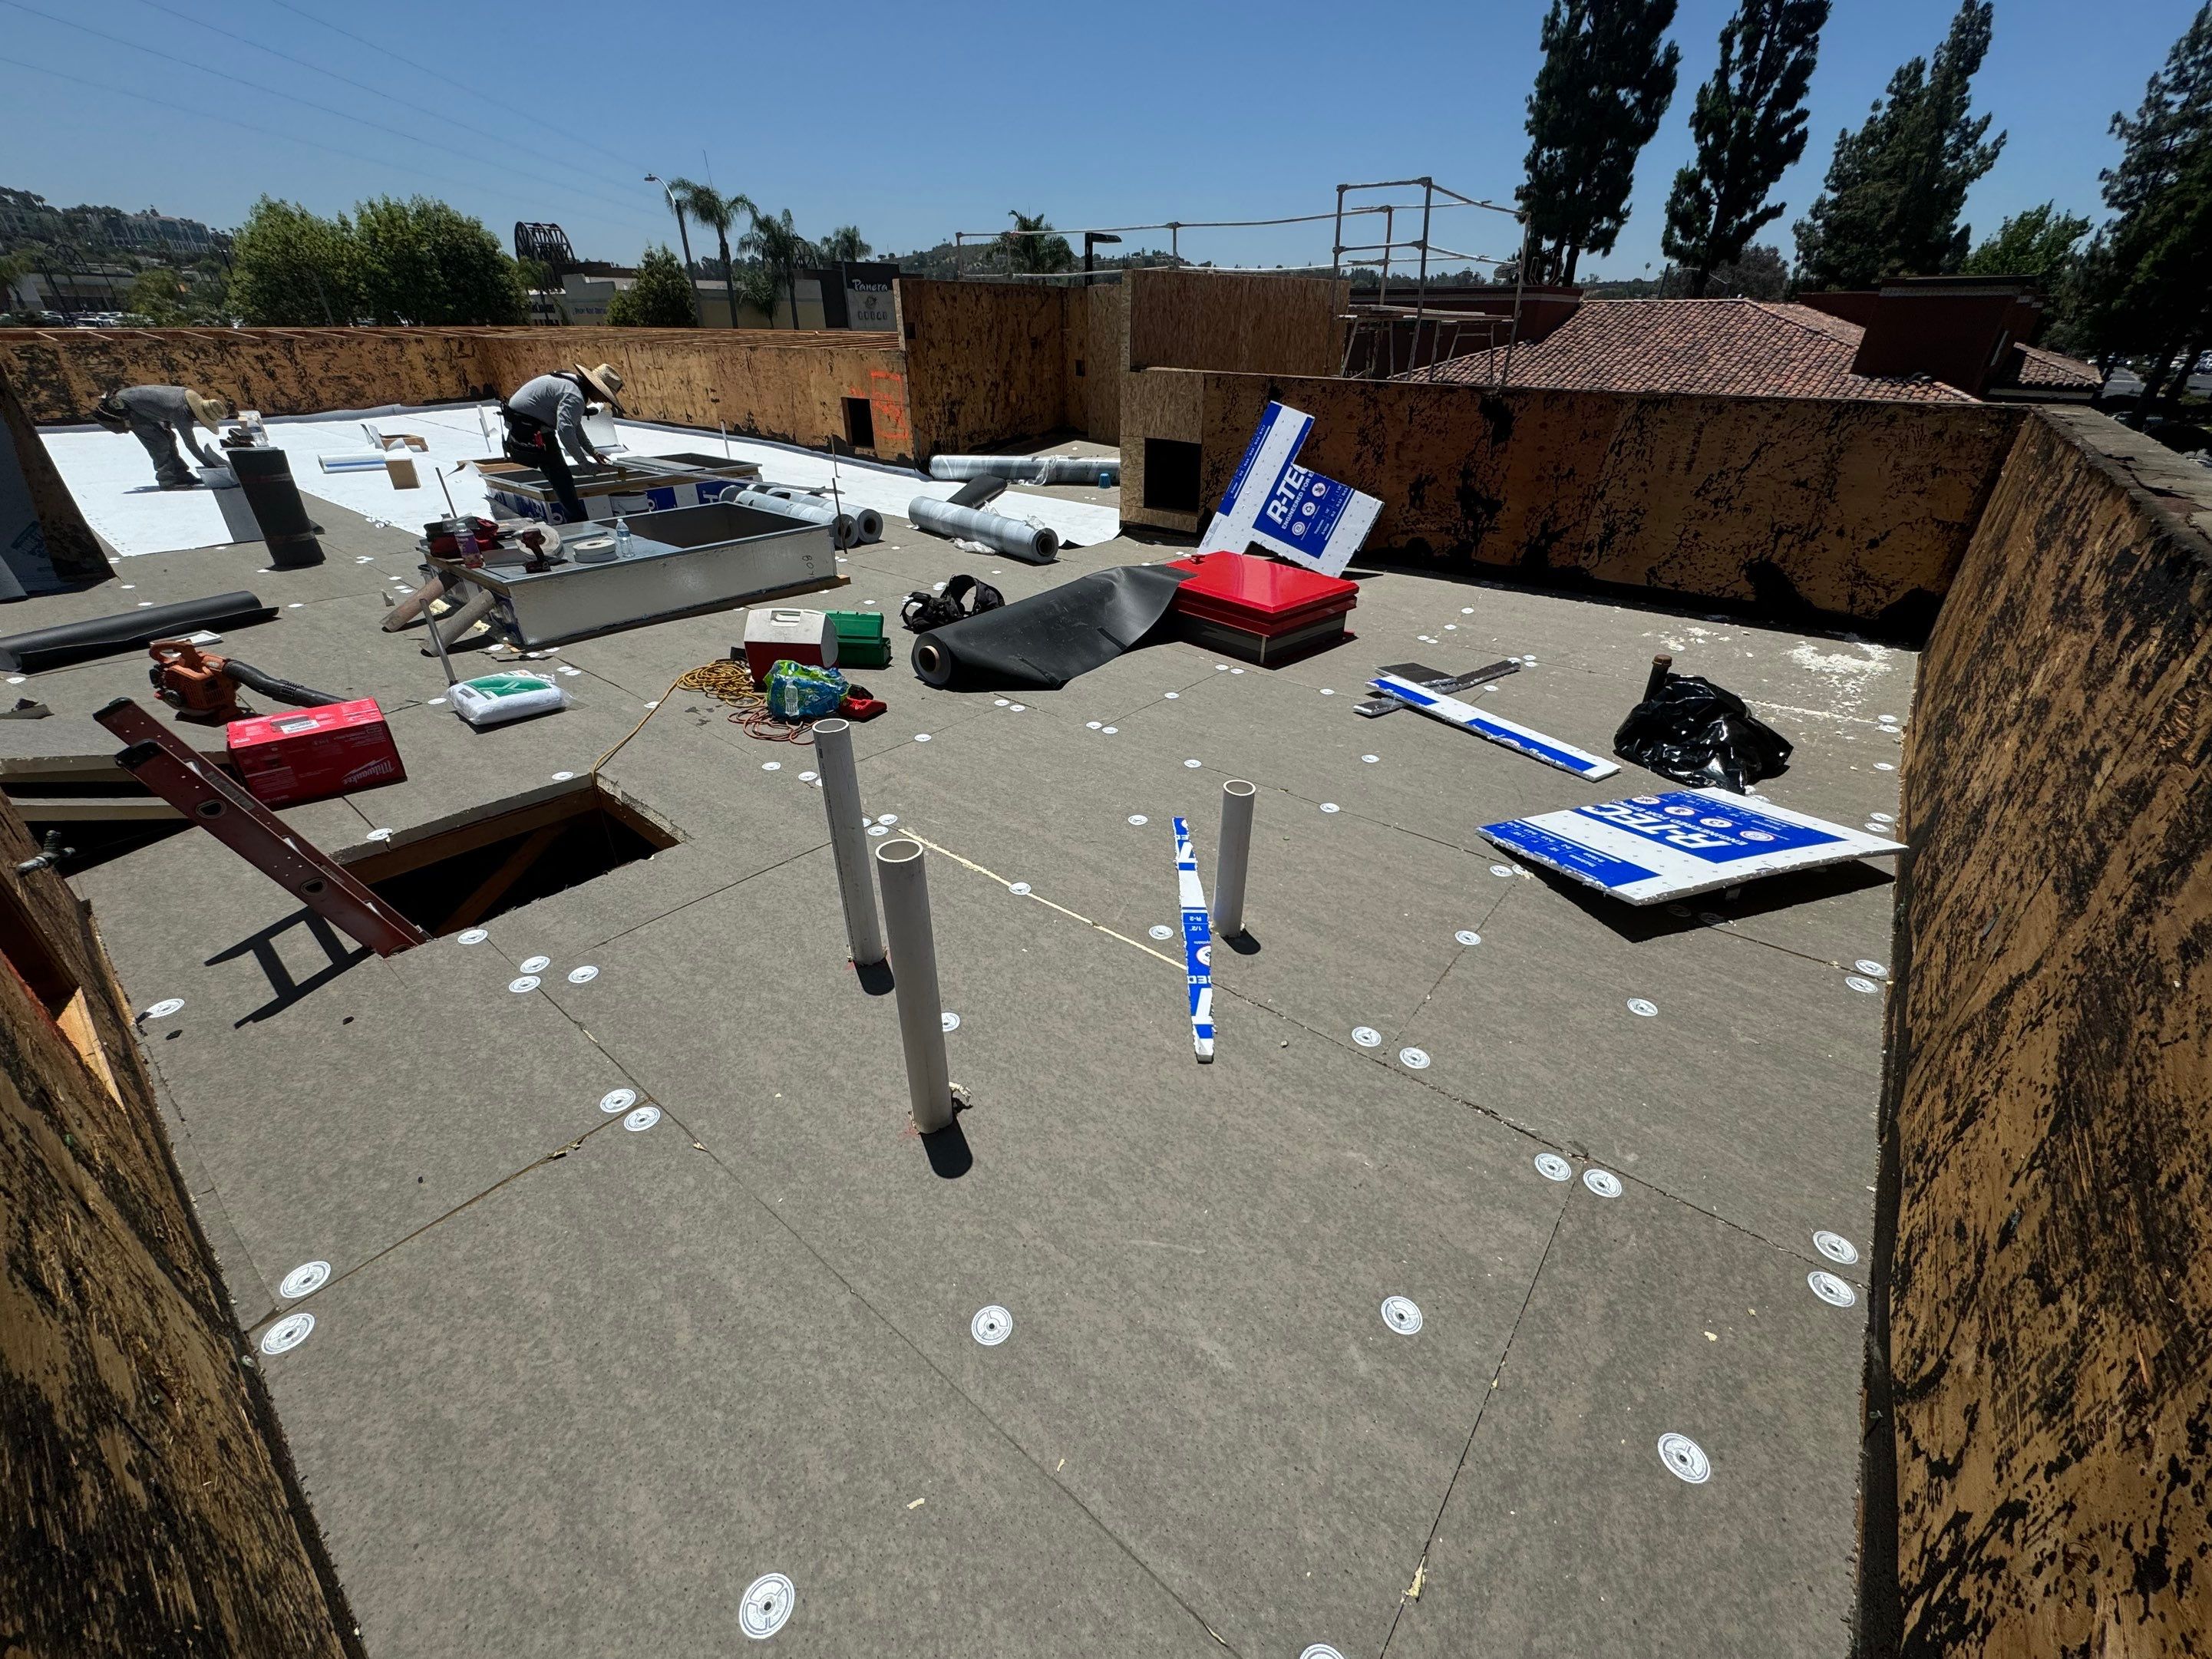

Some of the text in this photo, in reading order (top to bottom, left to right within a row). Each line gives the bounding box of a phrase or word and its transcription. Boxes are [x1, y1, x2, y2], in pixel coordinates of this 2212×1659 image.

[852, 279, 888, 292] Panera
[1281, 492, 1303, 529] ENGINEERED
[1301, 479, 1311, 491] FOR
[343, 760, 394, 785] Milwaukee
[1670, 819, 1748, 845] ENGINEERED
